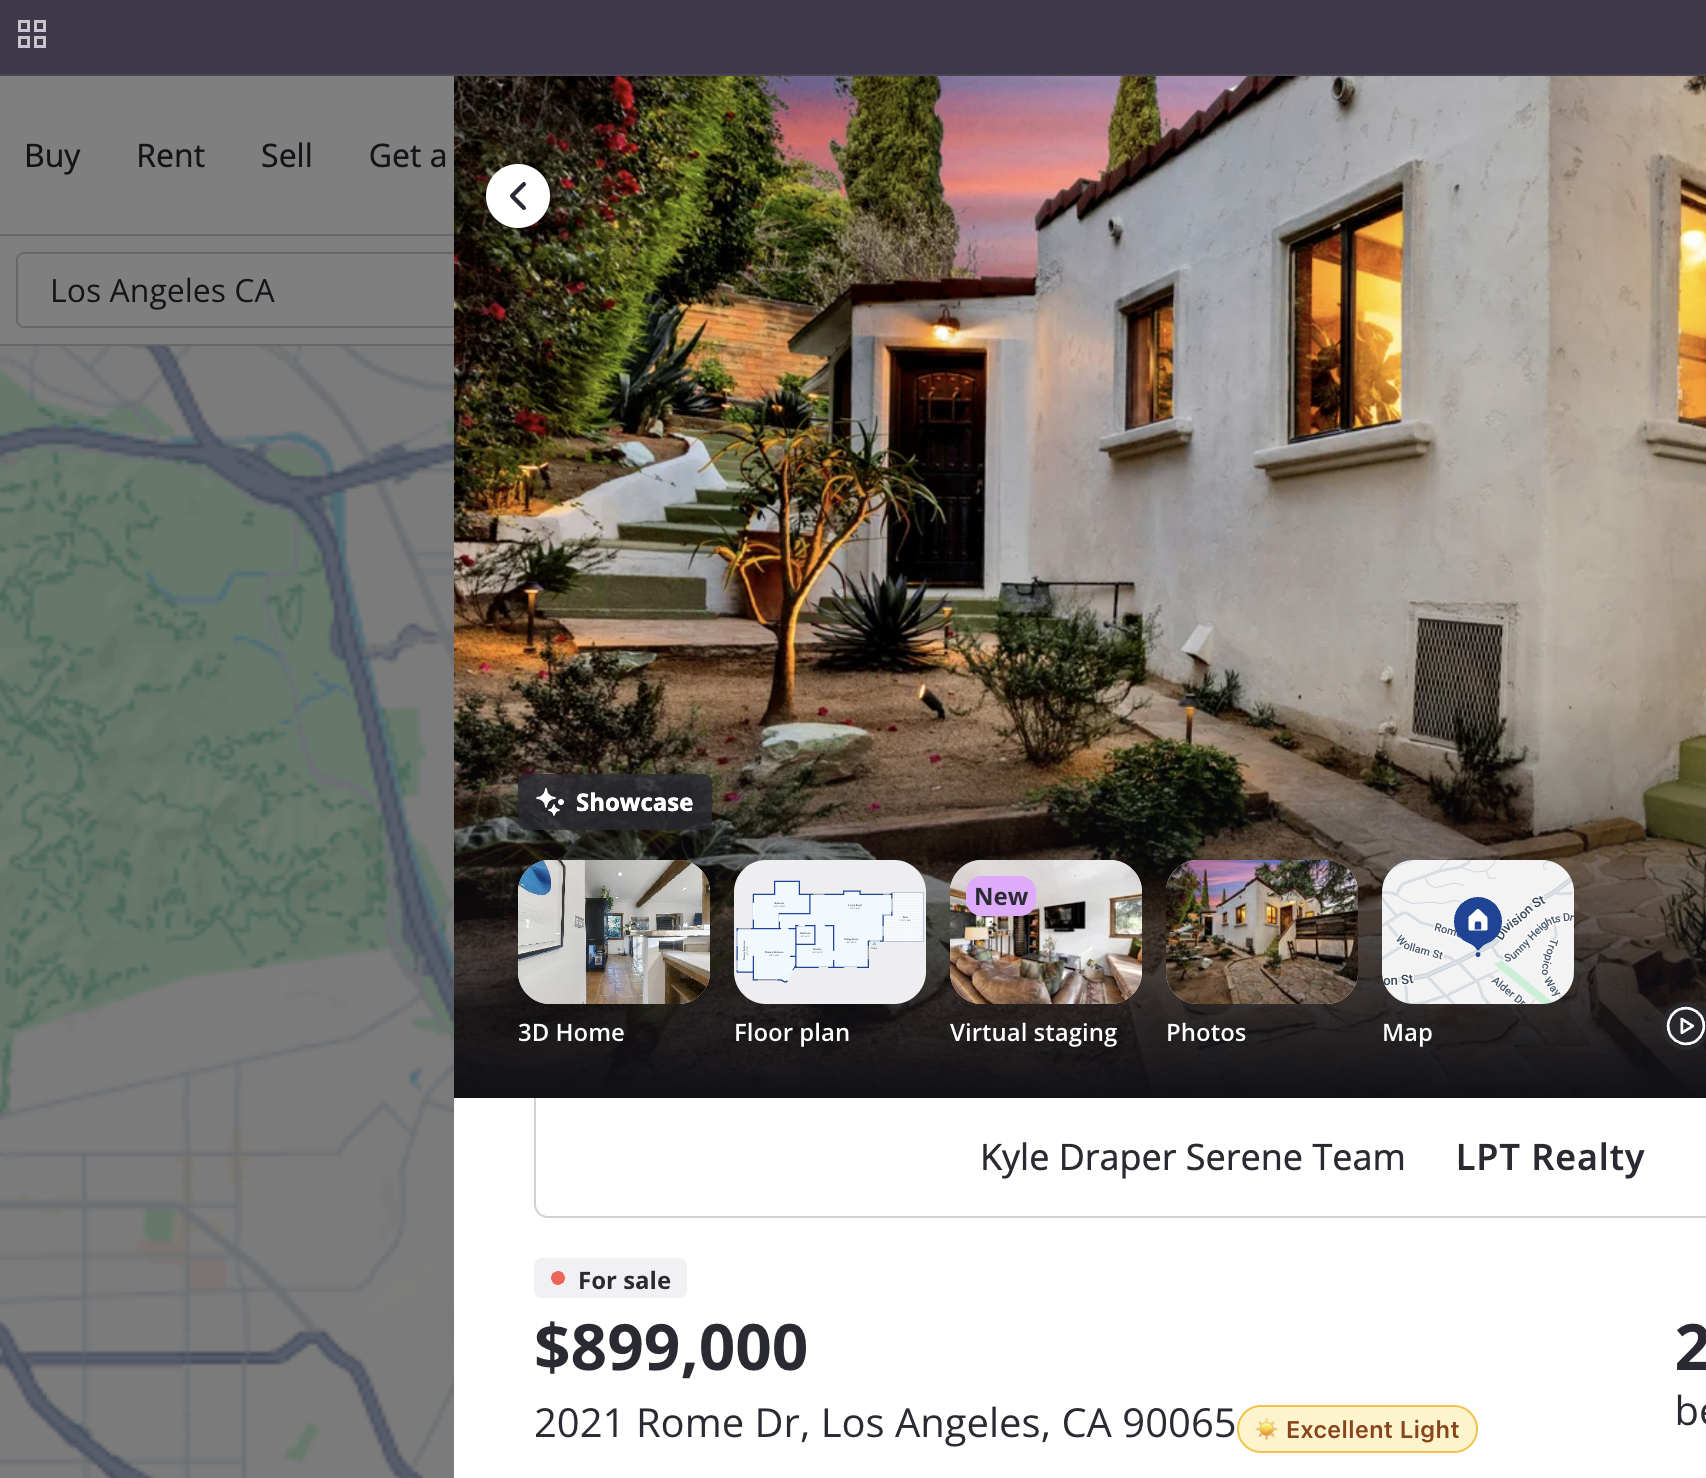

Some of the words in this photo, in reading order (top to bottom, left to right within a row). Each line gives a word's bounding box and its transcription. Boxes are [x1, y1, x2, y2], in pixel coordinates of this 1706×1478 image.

[26, 143, 81, 176] Buy
[138, 143, 206, 169] Rent
[261, 141, 312, 169] Sell
[369, 142, 422, 169] Get
[430, 148, 446, 169] a
[52, 278, 101, 304] Los
[108, 276, 226, 311] Angeles
[235, 278, 276, 304] CA
[576, 791, 694, 813] Showcase
[975, 887, 1029, 906] New
[1532, 895, 1546, 908] St
[1396, 934, 1430, 956] Wollam
[1432, 949, 1443, 960] St
[1504, 939, 1531, 963] Sunny
[1527, 915, 1561, 941] Heights
[1540, 939, 1559, 976] Tropico
[1401, 974, 1414, 985] St
[1491, 977, 1515, 998] Alder
[1544, 976, 1561, 997] Way
[518, 1022, 549, 1042] 3D
[556, 1023, 625, 1042] Home
[735, 1021, 794, 1042] Floor
[800, 1022, 850, 1048] plan
[949, 1021, 1027, 1042] Virtual
[1033, 1022, 1118, 1048] staging
[1167, 1021, 1247, 1042] Photos
[1383, 1023, 1433, 1048] Map
[982, 1141, 1049, 1180] Kyle
[1061, 1143, 1177, 1180] Draper
[1186, 1142, 1303, 1172] Serene
[1311, 1143, 1404, 1172] Team
[1458, 1143, 1521, 1171] LPT
[1533, 1141, 1646, 1180] Realty
[579, 1271, 618, 1290] For
[623, 1269, 671, 1290] sale
[534, 1319, 808, 1381] $899,000
[535, 1407, 618, 1439] 2021
[639, 1407, 743, 1439] Rome
[757, 1407, 808, 1443] Dr,
[823, 1407, 884, 1439] Los
[894, 1405, 1049, 1448] Angeles,
[1063, 1407, 1113, 1439] CA
[1123, 1407, 1236, 1439] 90065
[1287, 1419, 1393, 1439] Excellent
[1400, 1418, 1460, 1444] Light
